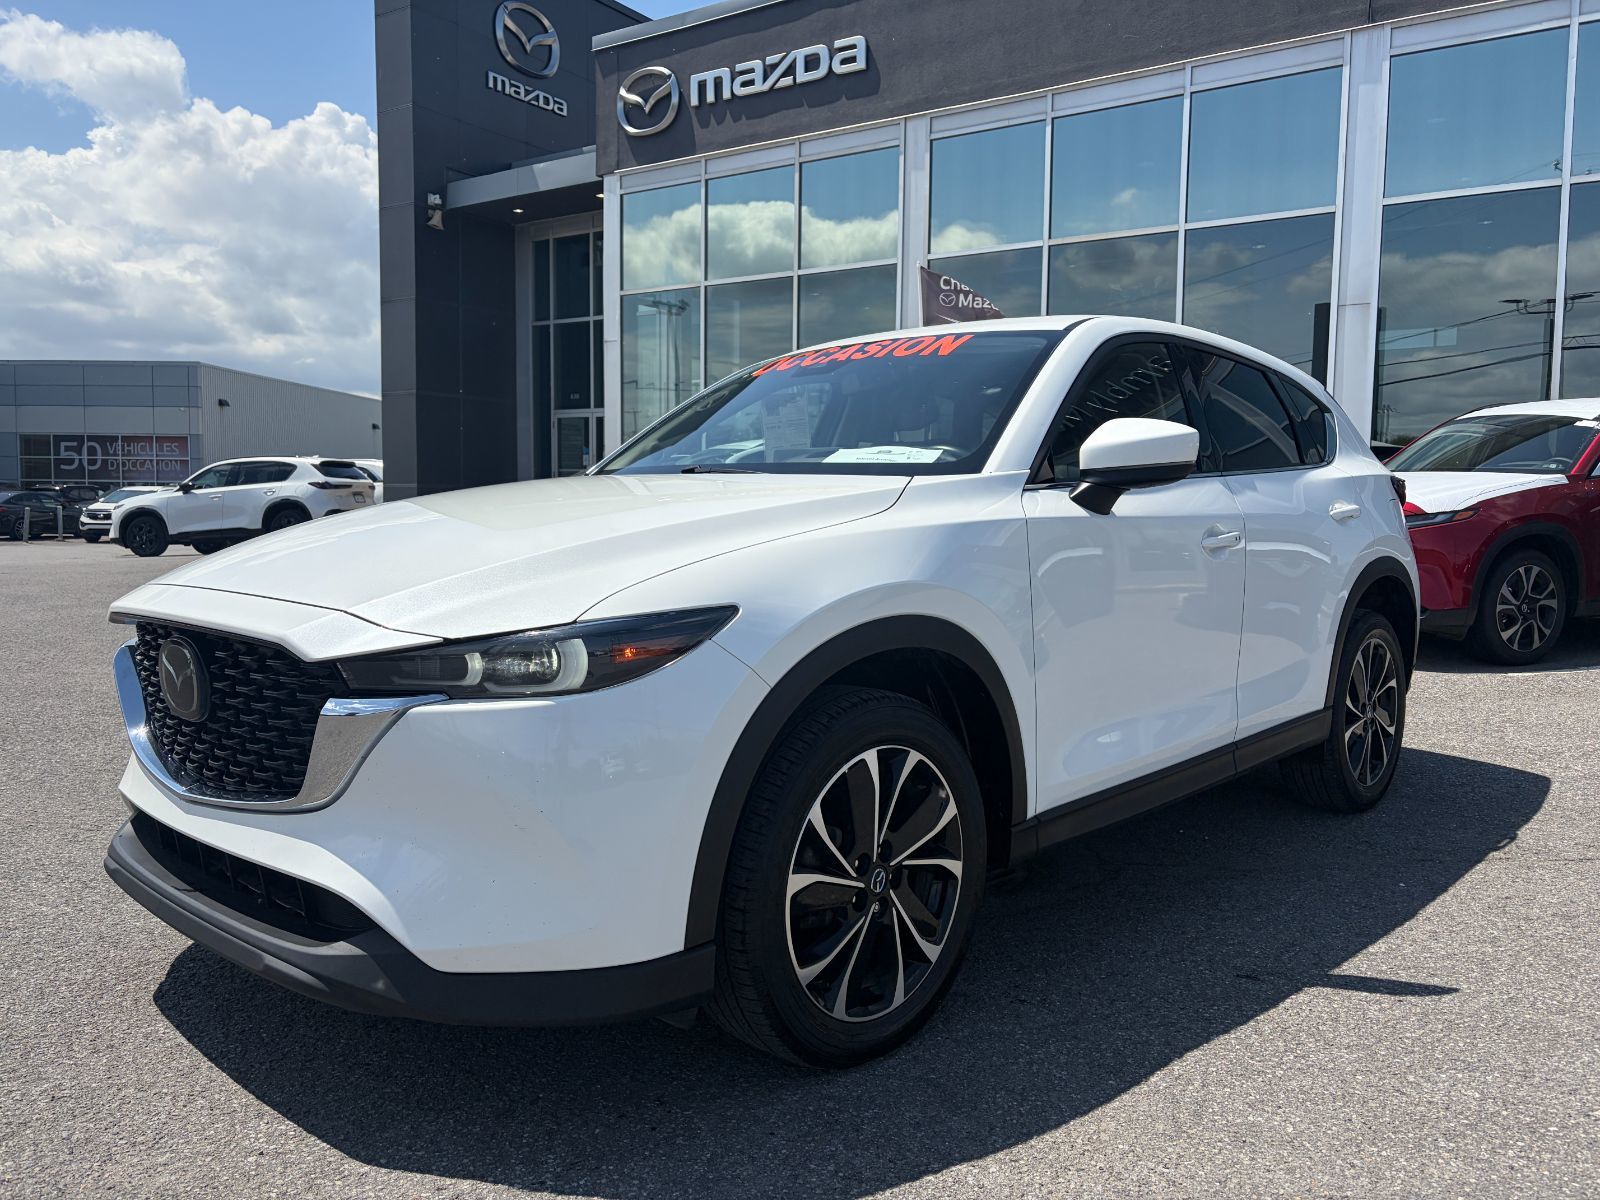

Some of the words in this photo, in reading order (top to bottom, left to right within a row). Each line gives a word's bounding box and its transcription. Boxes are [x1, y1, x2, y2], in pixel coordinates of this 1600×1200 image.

[940, 275, 974, 291] Cha
[752, 334, 974, 378] OCCASION
[60, 441, 102, 470] 50
